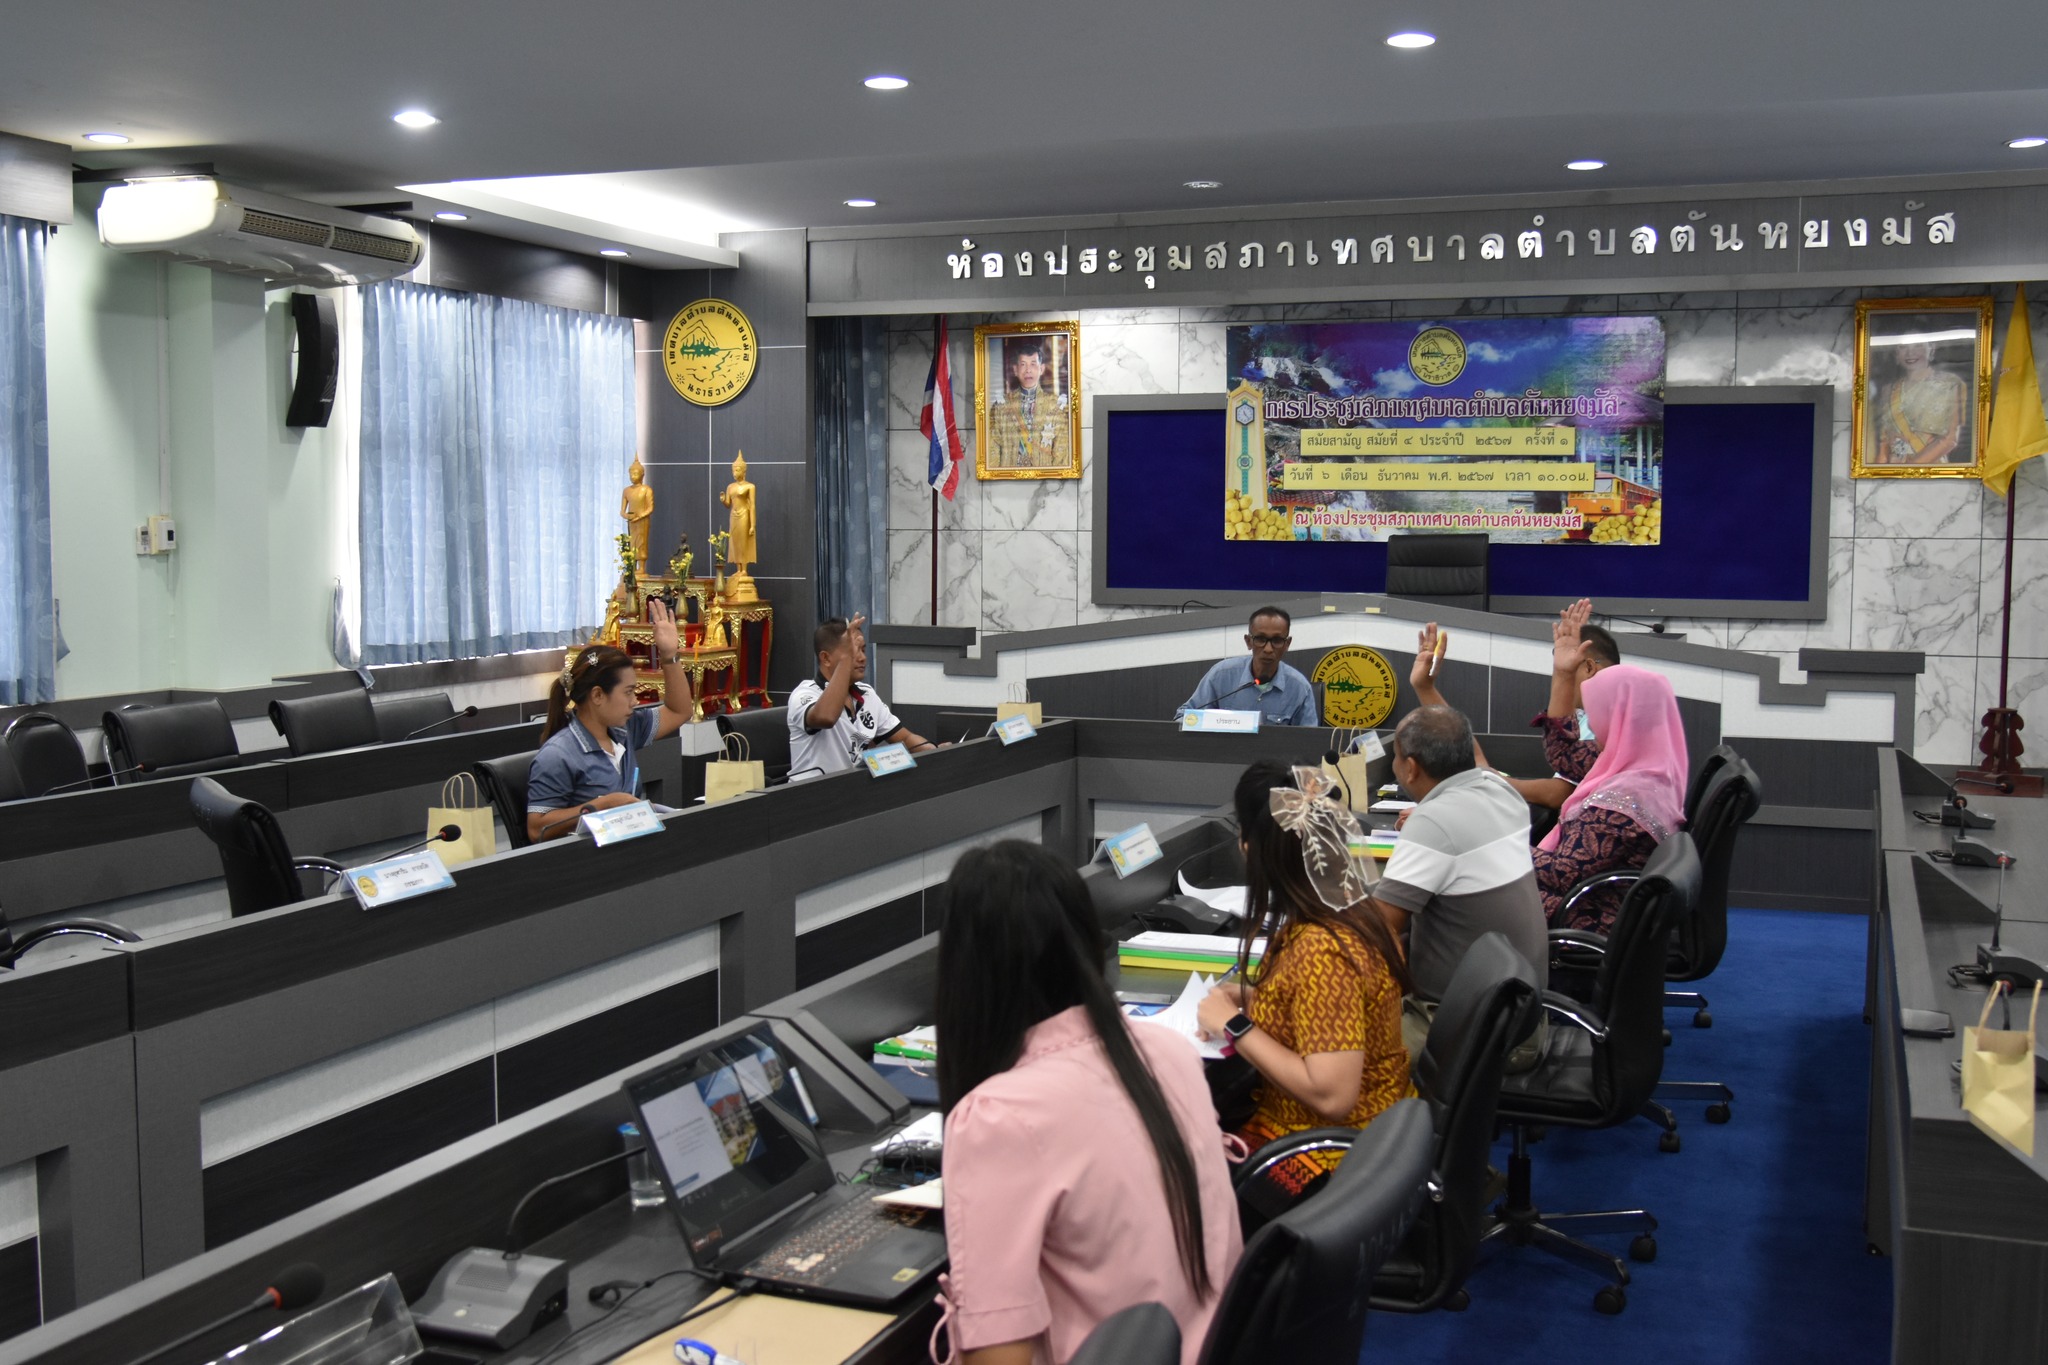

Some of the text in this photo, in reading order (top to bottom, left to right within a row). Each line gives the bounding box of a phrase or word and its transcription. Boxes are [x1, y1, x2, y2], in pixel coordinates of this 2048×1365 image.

[1265, 388, 1619, 426] การประชุมสภาเทศบาลตำบลตันหยงมัส
[1307, 432, 1361, 450] สมัยสามัญ
[1366, 429, 1398, 446] สมัยที่
[1419, 432, 1464, 446] ประจำปี
[1525, 427, 1555, 446] ครั้งที่
[1289, 465, 1313, 481] วันที่
[1340, 467, 1368, 481] เดือน
[1377, 468, 1419, 482] ธันวาคม
[1427, 471, 1452, 482] พ.ศ.
[1505, 471, 1531, 482] เวลา
[1295, 505, 1582, 531] ณ ห้องประชุมสภาเทศบาลตำบลตันหยงมัส
